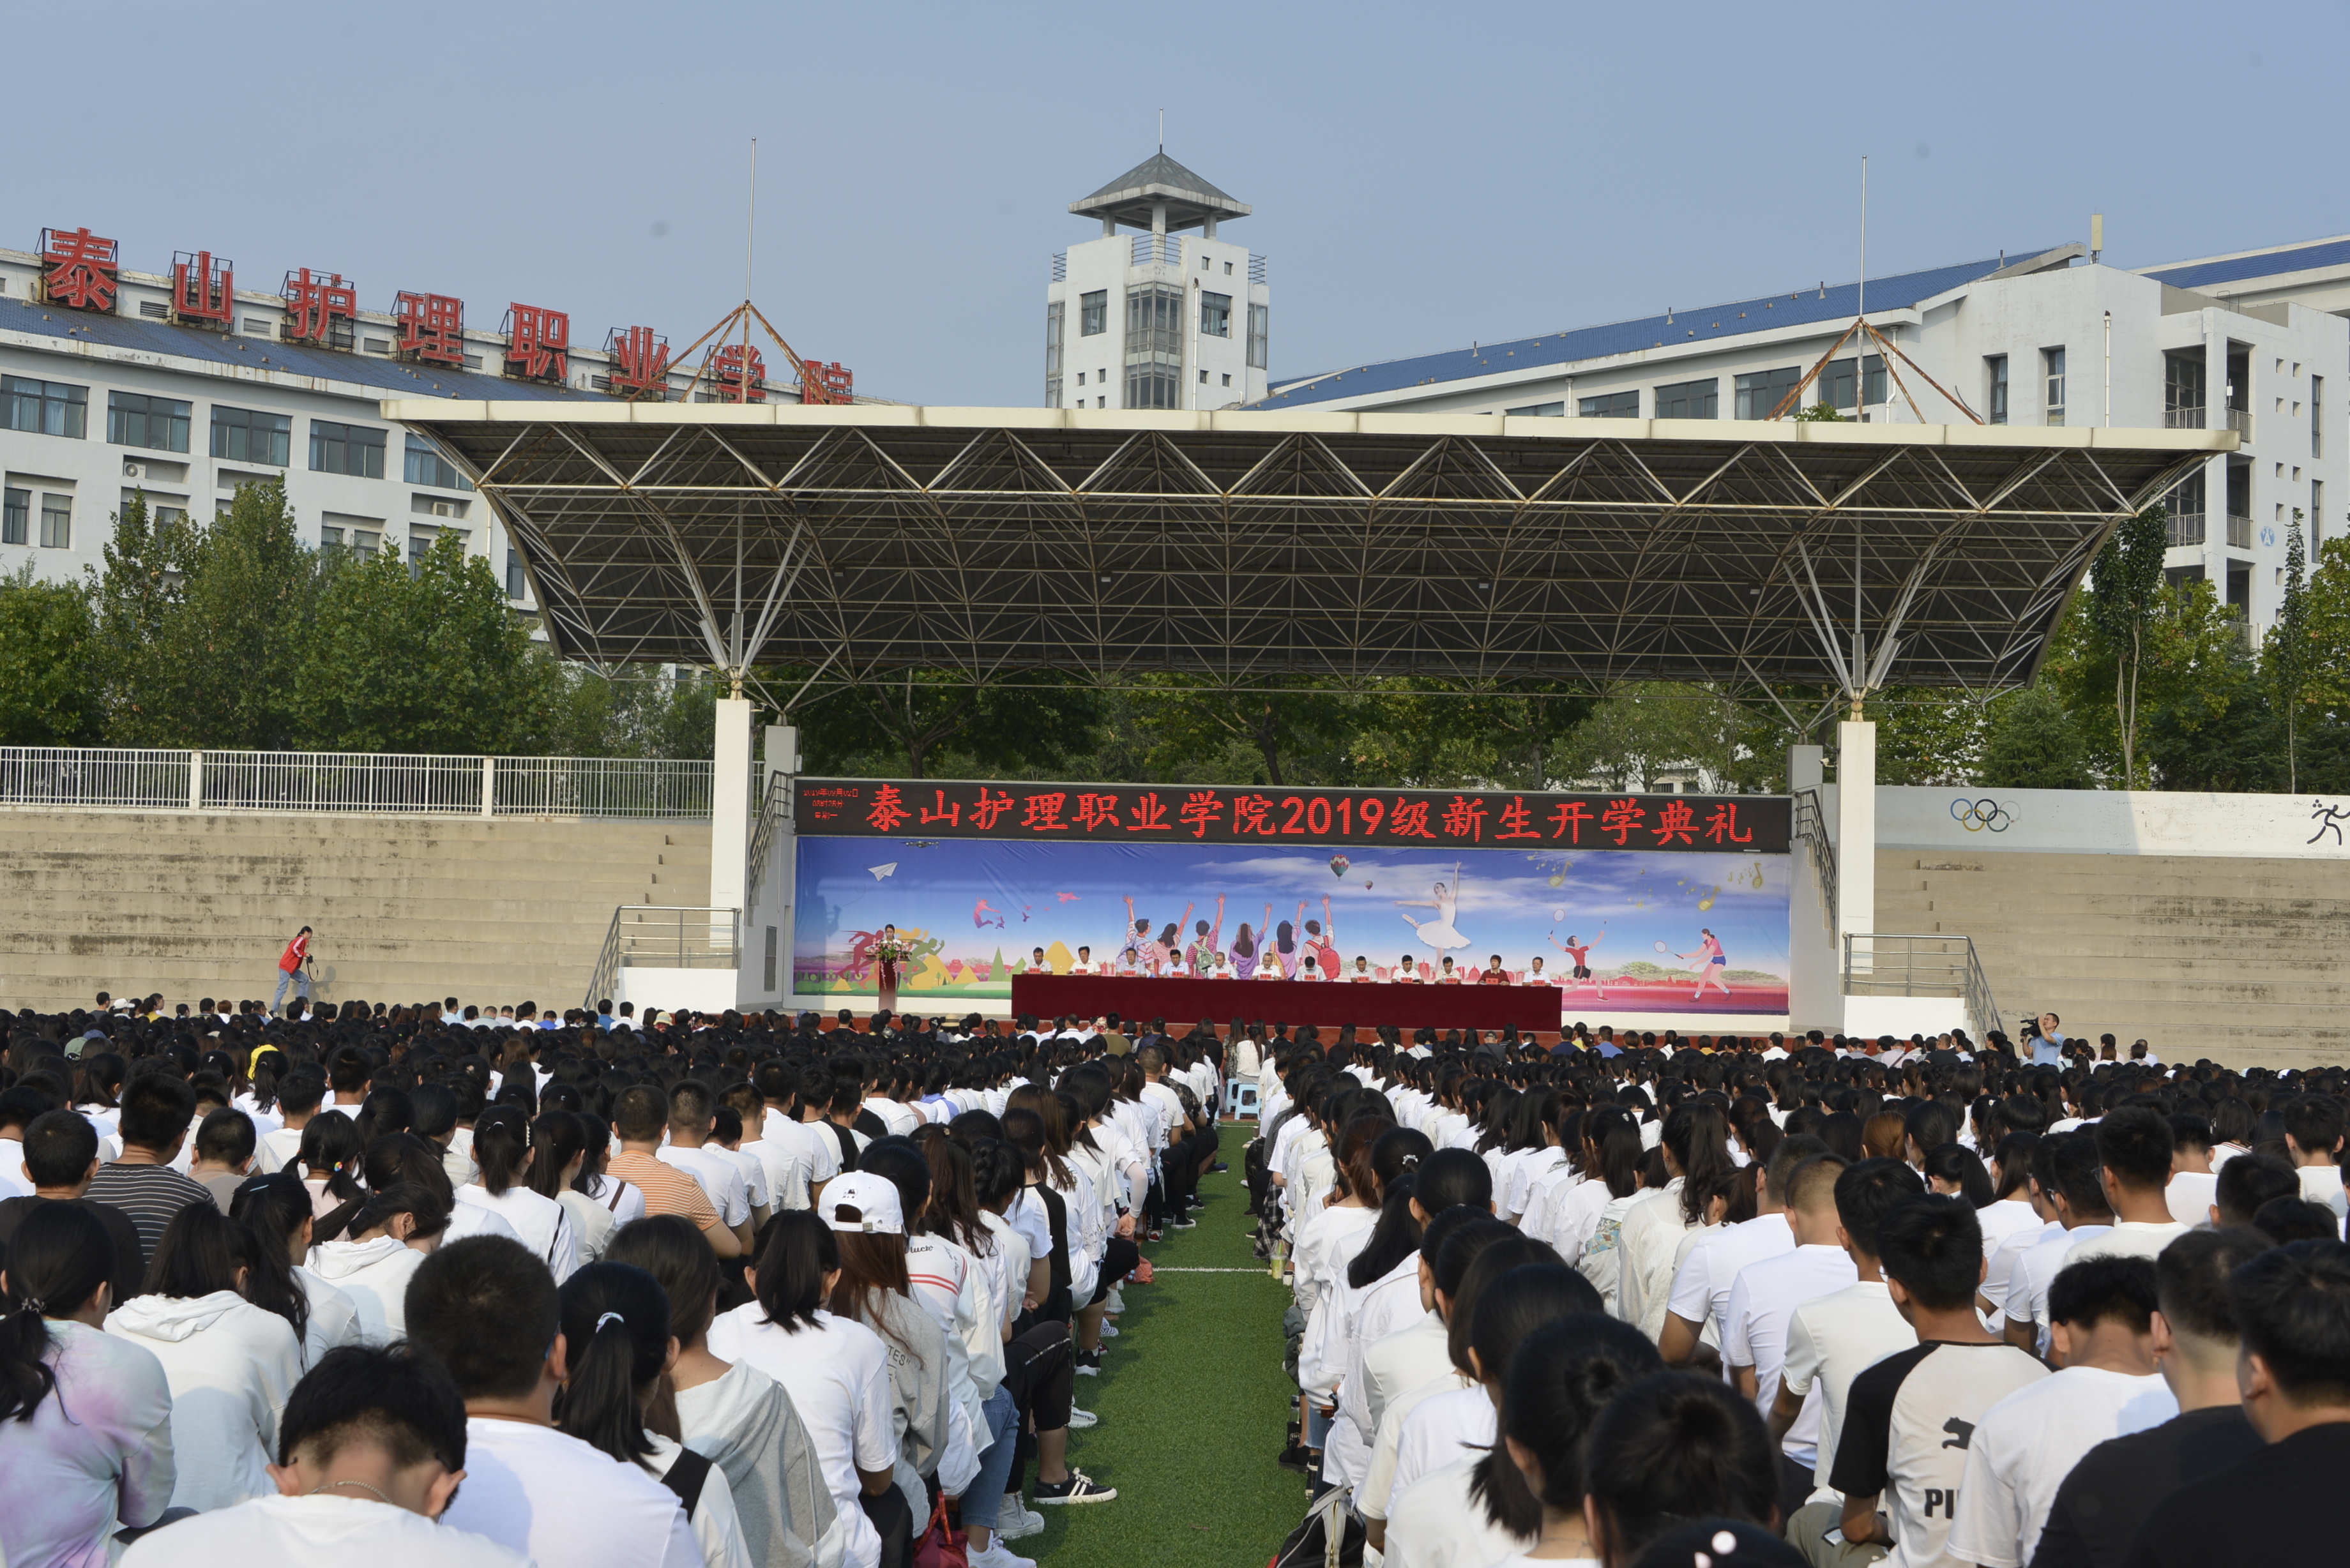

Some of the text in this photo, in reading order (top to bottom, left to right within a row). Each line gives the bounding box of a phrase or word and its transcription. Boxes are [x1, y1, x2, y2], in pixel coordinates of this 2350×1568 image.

[43, 227, 854, 405] 泰山护理职业学院
[866, 783, 1754, 845] 泰山护理职业学院2019级新生开学典礼
